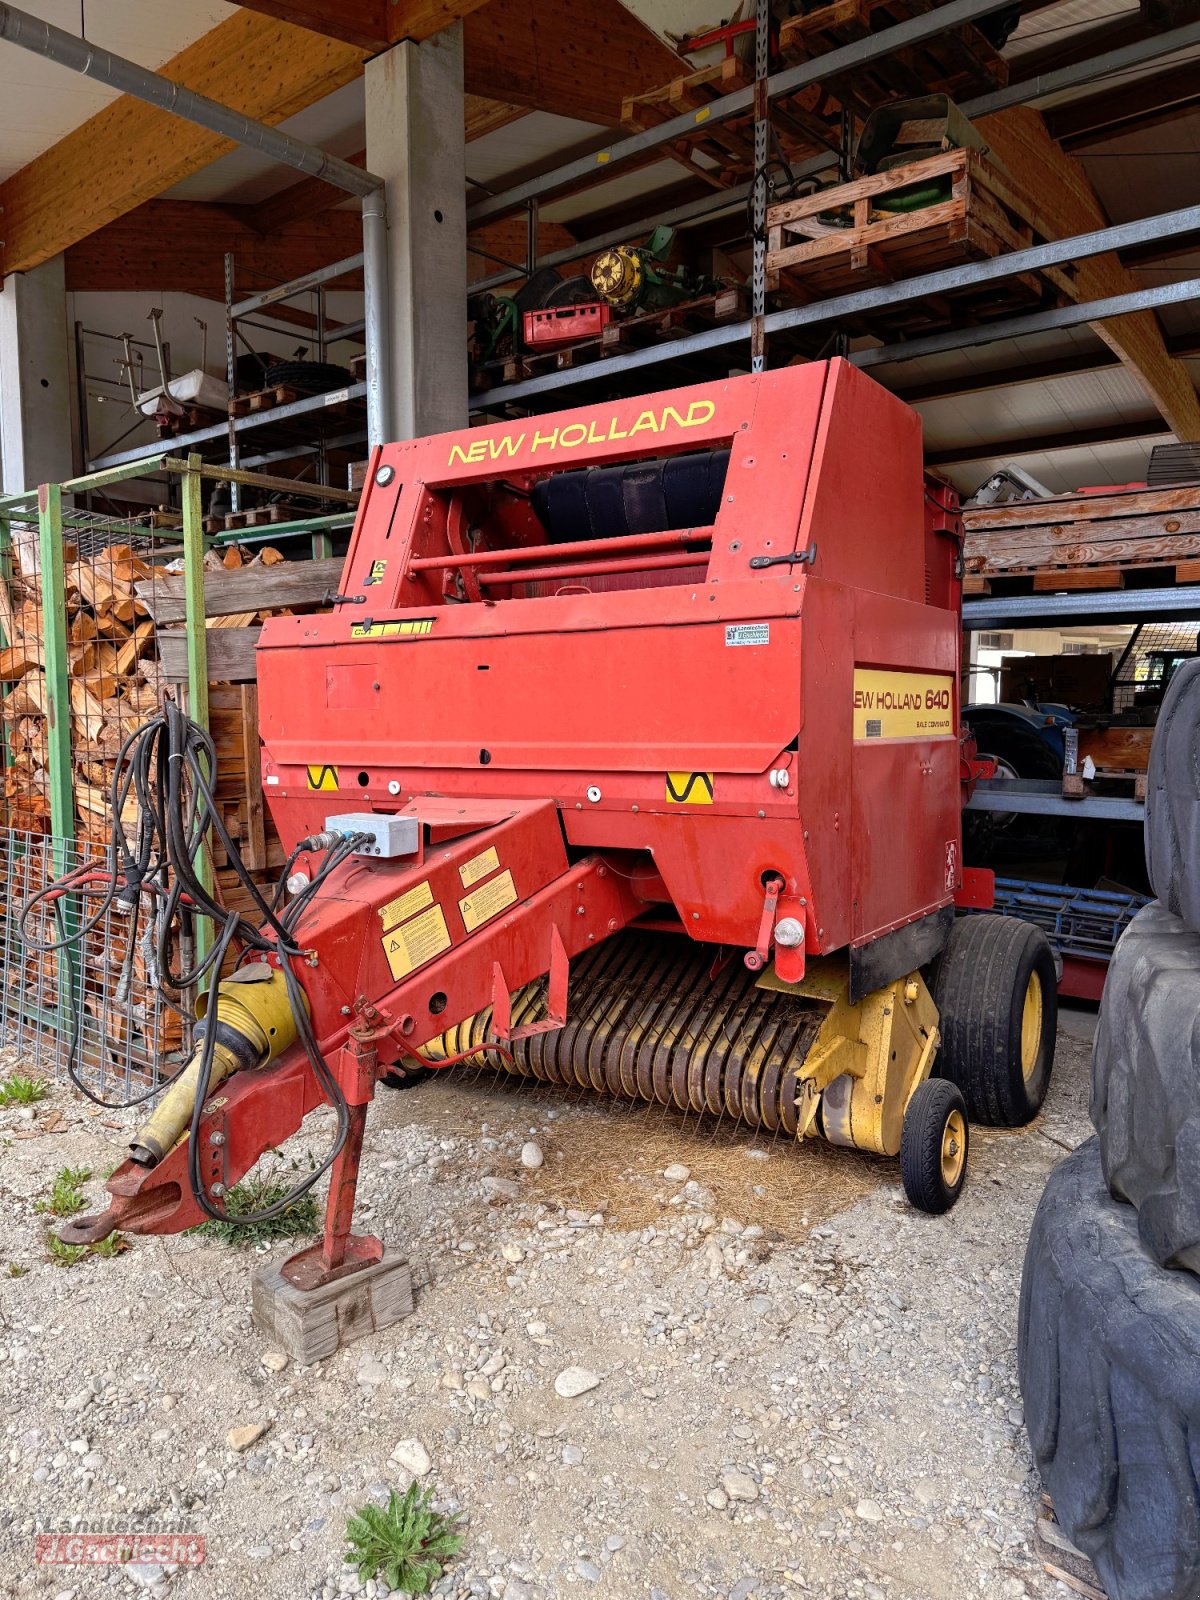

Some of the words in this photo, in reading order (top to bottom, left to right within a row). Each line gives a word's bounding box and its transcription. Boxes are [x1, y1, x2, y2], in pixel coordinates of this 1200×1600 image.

[448, 433, 526, 466] NEW
[530, 400, 716, 453] HOLLAND
[853, 690, 874, 709] EW
[876, 691, 922, 710] HOLLAND
[925, 689, 950, 710] 640
